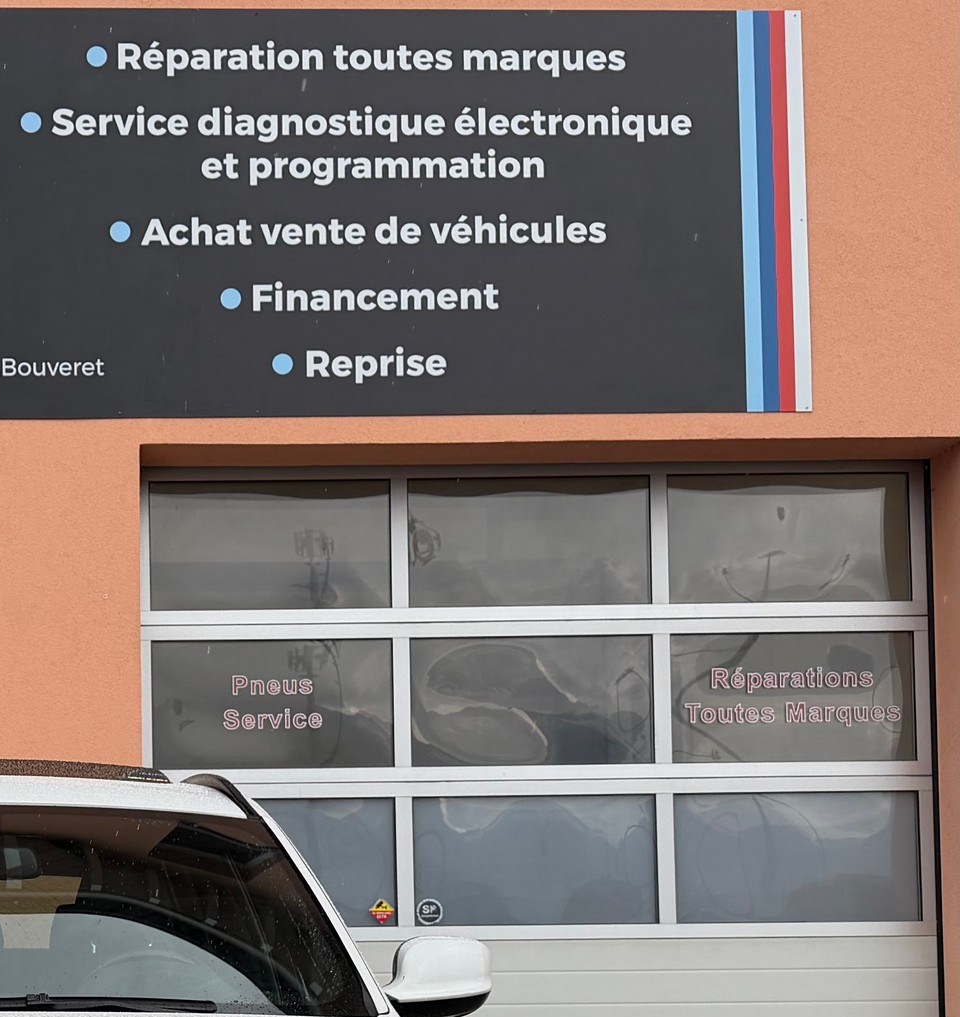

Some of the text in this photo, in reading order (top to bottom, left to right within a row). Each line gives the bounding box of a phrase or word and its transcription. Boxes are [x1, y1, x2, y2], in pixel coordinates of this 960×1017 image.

[117, 40, 626, 78] Réparation toutes marques
[51, 105, 692, 143] Service diagnostique électronique
[201, 148, 545, 186] et programmation
[140, 213, 607, 246] Achat vente de véhicules
[252, 280, 499, 312] Financement
[306, 346, 447, 384] Reprise
[231, 675, 314, 696] Pneus
[710, 666, 874, 694] Réparations
[223, 708, 323, 730] Service
[684, 701, 902, 727] Toutes Marques
